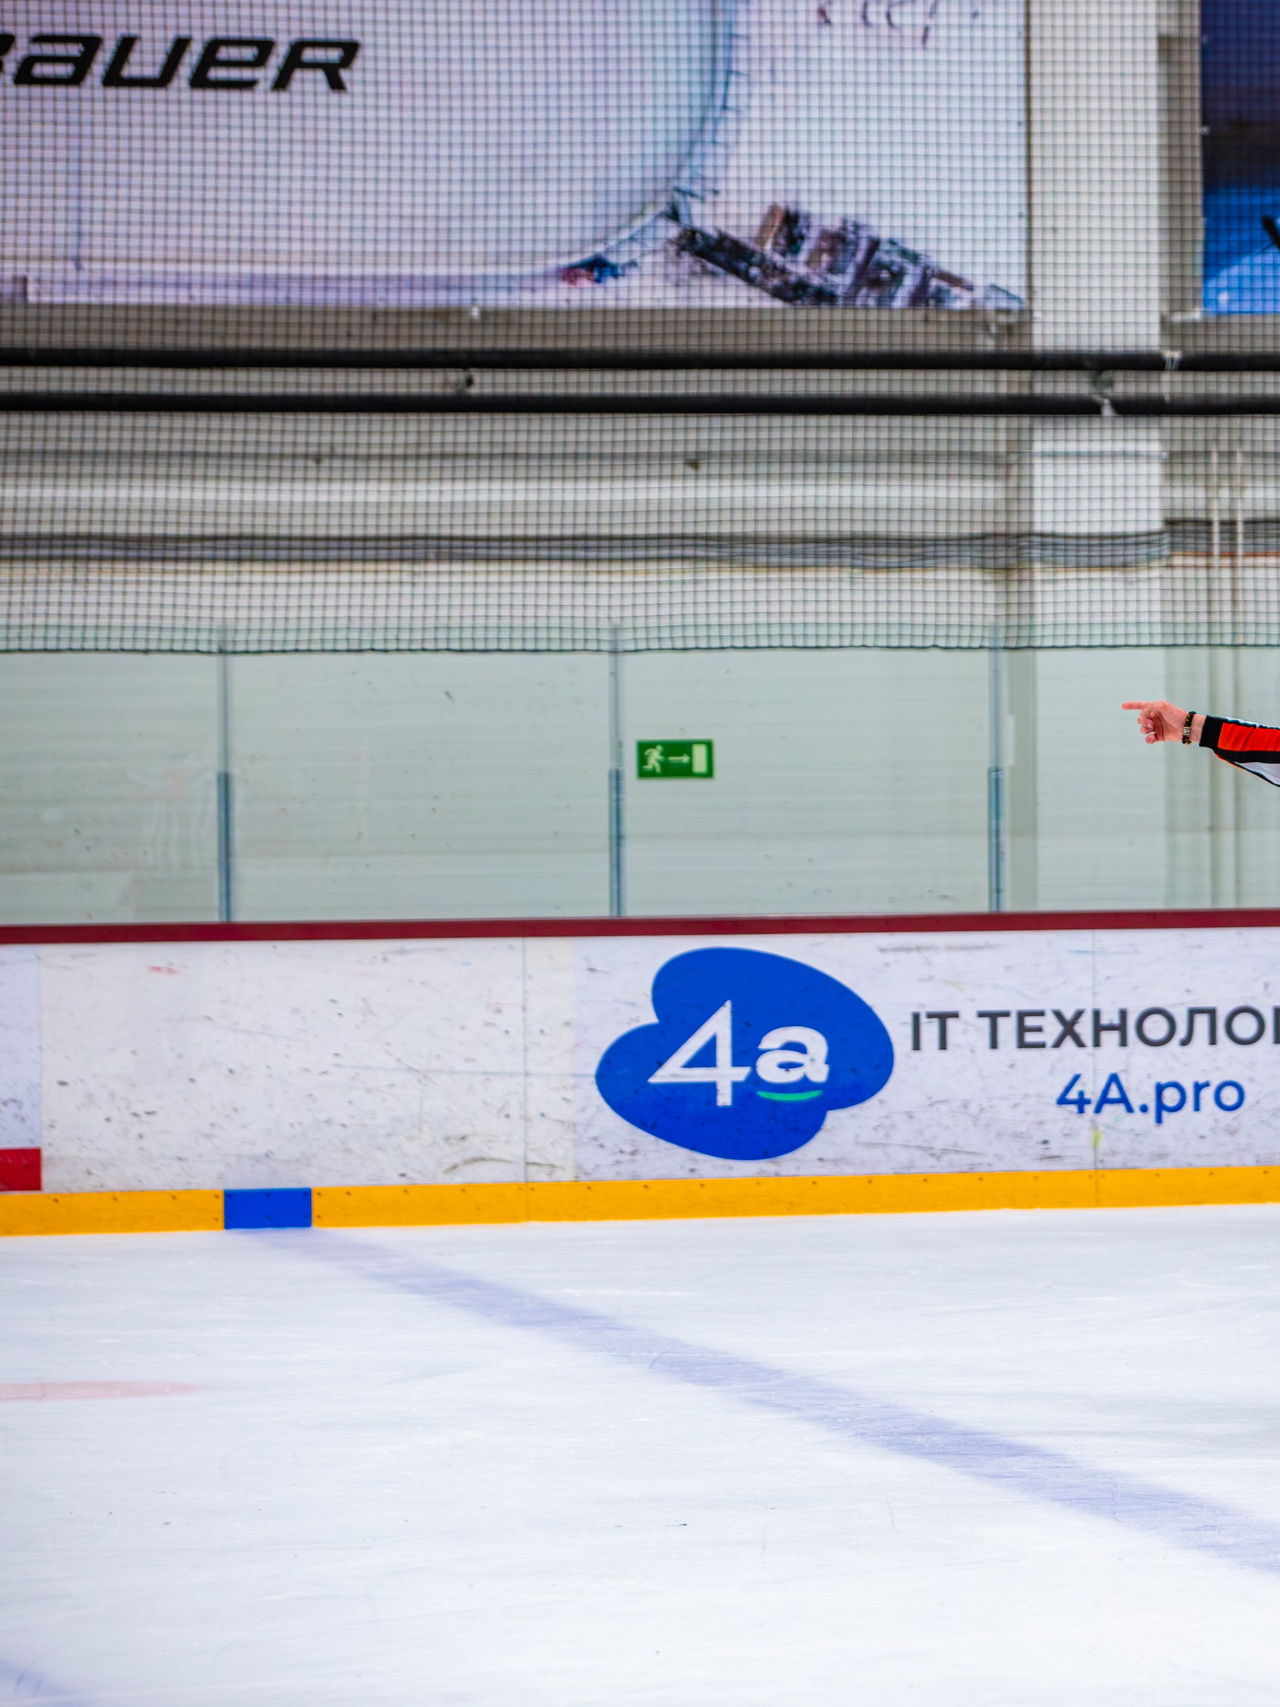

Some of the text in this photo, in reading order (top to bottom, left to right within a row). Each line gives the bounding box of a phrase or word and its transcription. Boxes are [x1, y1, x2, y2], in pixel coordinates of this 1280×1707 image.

[0, 32, 361, 92] AUER
[911, 1010, 960, 1051] IT
[1055, 1072, 1246, 1125] 4A.pro
